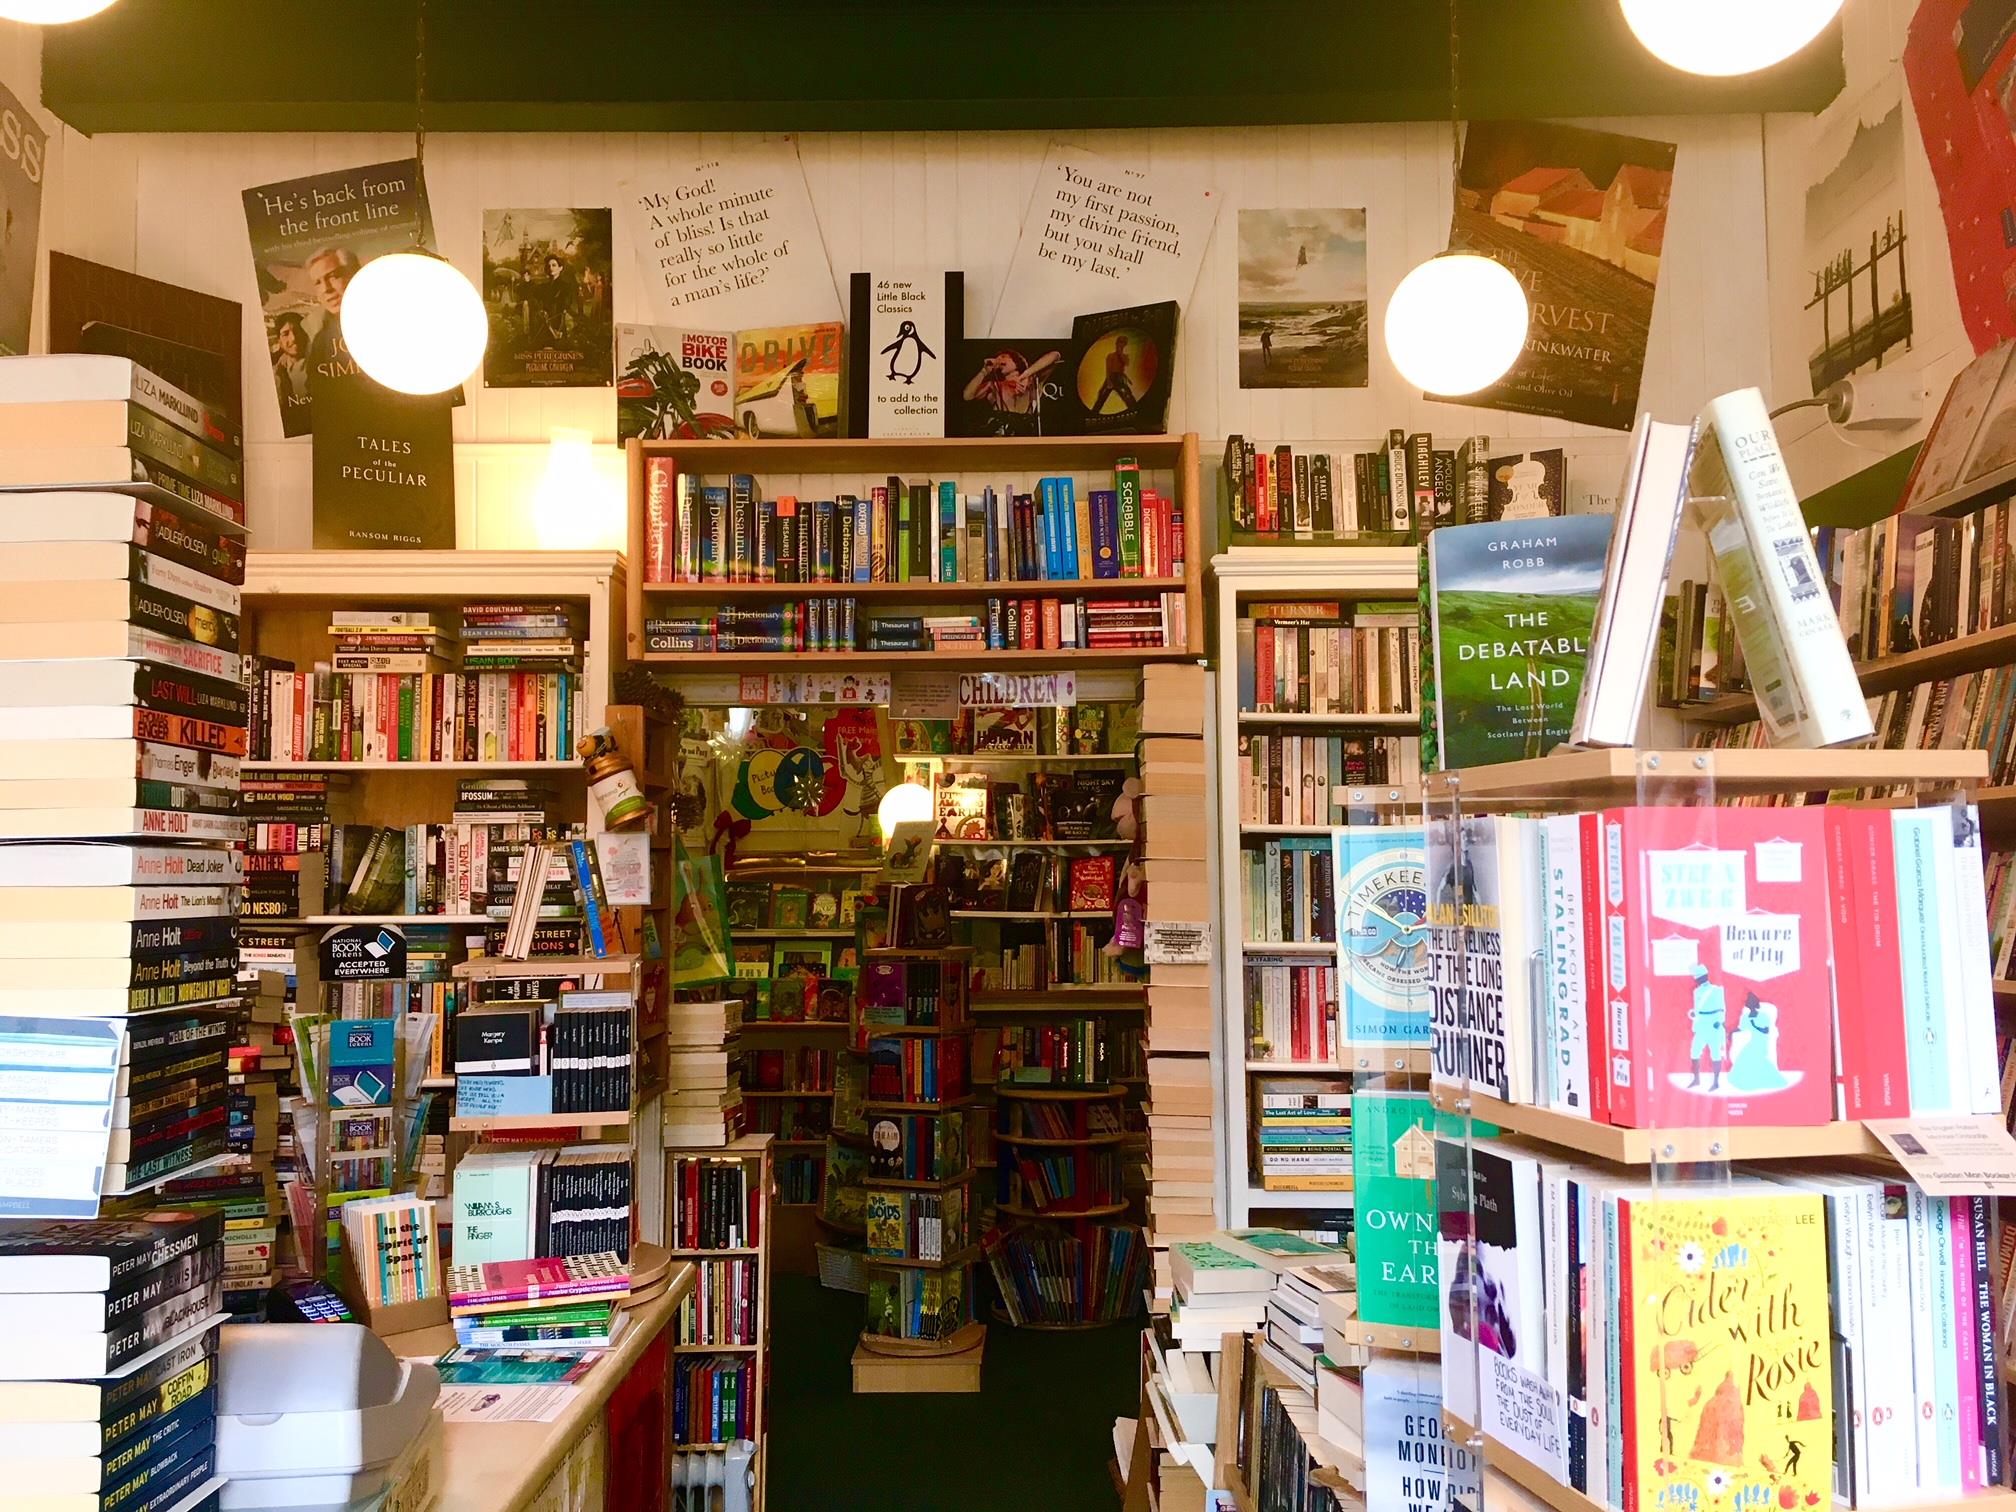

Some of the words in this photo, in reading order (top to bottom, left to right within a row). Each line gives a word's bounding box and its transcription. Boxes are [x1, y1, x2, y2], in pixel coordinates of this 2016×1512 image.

[265, 192, 308, 216] He's
[313, 184, 356, 207] back
[362, 178, 406, 197] from
[675, 179, 716, 201] God!
[1097, 181, 1122, 197] are
[1126, 190, 1153, 207] not
[280, 219, 309, 236] the
[315, 210, 360, 230] front
[365, 203, 399, 220] line
[650, 215, 663, 230] A
[668, 202, 713, 225] whole
[718, 187, 774, 211] minute
[1056, 189, 1081, 208] my
[1085, 195, 1114, 216] first
[1117, 208, 1180, 237] passion,
[655, 231, 670, 249] of
[676, 221, 715, 243] bliss!
[720, 217, 734, 231] Is
[738, 209, 770, 227] that
[1050, 209, 1075, 227] my
[1079, 214, 1127, 239] divine
[1131, 229, 1181, 258] friend,
[660, 246, 703, 268] really
[708, 243, 725, 255] so
[728, 230, 764, 250] little
[1044, 223, 1069, 244] but
[1073, 236, 1102, 253] you
[1106, 243, 1144, 265] shall
[664, 272, 687, 288] for
[692, 265, 717, 280] the
[722, 250, 768, 272] whole
[774, 240, 789, 258] of
[1038, 242, 1057, 260] be
[1062, 253, 1087, 272] my
[671, 296, 680, 307] a
[684, 280, 731, 303] man's
[877, 292, 898, 301] Little
[901, 292, 926, 301] Black
[877, 304, 912, 314] Classics
[686, 334, 727, 345] MOTOR
[682, 344, 728, 359] BIKE
[740, 333, 836, 374] DRIVE
[682, 357, 727, 372] BOOK
[135, 375, 156, 397] LIZA
[158, 389, 198, 424] MARKLUND
[877, 395, 886, 403] to
[890, 394, 909, 403] add
[911, 394, 920, 402] to
[923, 393, 938, 403] the
[894, 406, 938, 415] collection
[357, 436, 412, 455] TALES
[1735, 430, 1771, 449] OUR
[385, 460, 397, 468] the
[342, 466, 427, 487] PECULIAR
[1122, 481, 1135, 542] SCRABBLE
[1488, 537, 1557, 552] GRAHAM
[1502, 557, 1545, 569] ROBB
[737, 610, 779, 621] Dictionary
[1270, 606, 1324, 616] TURNER
[1504, 612, 1548, 628] THE
[1007, 608, 1015, 641] Collins
[1024, 608, 1033, 640] Polish
[651, 637, 694, 648] Collins
[1459, 637, 1591, 660] DEBATABL
[960, 674, 1058, 705] CHILDREN
[1491, 670, 1570, 690] LAND
[1512, 716, 1549, 724] Between
[180, 718, 226, 749] KILLED
[143, 811, 166, 832] ANNE
[168, 812, 188, 833] HOLT
[137, 855, 162, 874] Anne
[164, 856, 184, 874] Holt
[186, 859, 205, 872] Dead
[206, 859, 224, 873] Joker
[249, 855, 284, 870] FATHER
[460, 844, 468, 870] EENY
[459, 871, 469, 901] MEENY
[241, 903, 250, 915] JO
[253, 902, 281, 914] NESBO
[136, 929, 160, 948] Anne
[162, 927, 181, 946] Holt
[248, 938, 286, 946] STREET
[535, 930, 571, 938] STREET
[1726, 924, 1792, 942] Beware
[332, 943, 362, 952] BOOK
[1567, 893, 1578, 1005] BREAKOUT
[1732, 947, 1744, 961] of
[1749, 945, 1784, 967] Pity
[135, 963, 159, 982] Anne
[161, 960, 181, 979] Holt
[184, 961, 204, 974] Beyond
[205, 959, 214, 970] the
[215, 957, 229, 969] Truth
[335, 967, 390, 975] EVERYWHERE
[1428, 951, 1442, 981] OF
[1476, 958, 1502, 991] LONG
[1553, 868, 1571, 1067] STALINGRAD
[1428, 986, 1504, 1036] DISTANCE
[1356, 1025, 1397, 1034] SIMON
[1571, 1019, 1580, 1042] AT
[1430, 1027, 1508, 1088] RUNNER
[468, 1208, 512, 1216] BURROUGHS
[1795, 1214, 1815, 1225] LEE
[1974, 1197, 1985, 1232] SUSAN
[384, 1225, 396, 1235] In
[400, 1222, 420, 1232] the
[154, 1237, 166, 1250] THE
[377, 1238, 413, 1251] Spirit
[416, 1235, 428, 1245] of
[1976, 1235, 1986, 1271] HILL
[112, 1258, 135, 1277] PETER
[136, 1250, 152, 1267] MAY
[152, 1233, 198, 1264] CHESSMEN
[386, 1252, 422, 1264] Spark
[401, 1267, 423, 1275] SMITH
[1658, 1272, 1749, 1338] Cider
[1979, 1282, 1989, 1305] THE
[1728, 1284, 1803, 1344] with
[1980, 1306, 1992, 1363] WOMAN
[1494, 1356, 1517, 1383] BOOKS
[1747, 1339, 1823, 1406] Rosie
[1984, 1365, 1993, 1379] IN
[167, 1369, 194, 1395] COFFIN
[105, 1414, 135, 1442] PETER
[139, 1398, 157, 1421] MAY
[171, 1385, 192, 1407] ROAD
[1496, 1378, 1515, 1398] FROM
[1518, 1391, 1534, 1410] THE
[1536, 1398, 1554, 1426] SOUL
[1497, 1394, 1510, 1413] THE
[1513, 1401, 1533, 1425] DUST
[1535, 1418, 1543, 1429] OF
[1985, 1382, 1996, 1425] BLACK
[1500, 1411, 1541, 1446] EVERYDAY
[1543, 1435, 1561, 1459] LIFE
